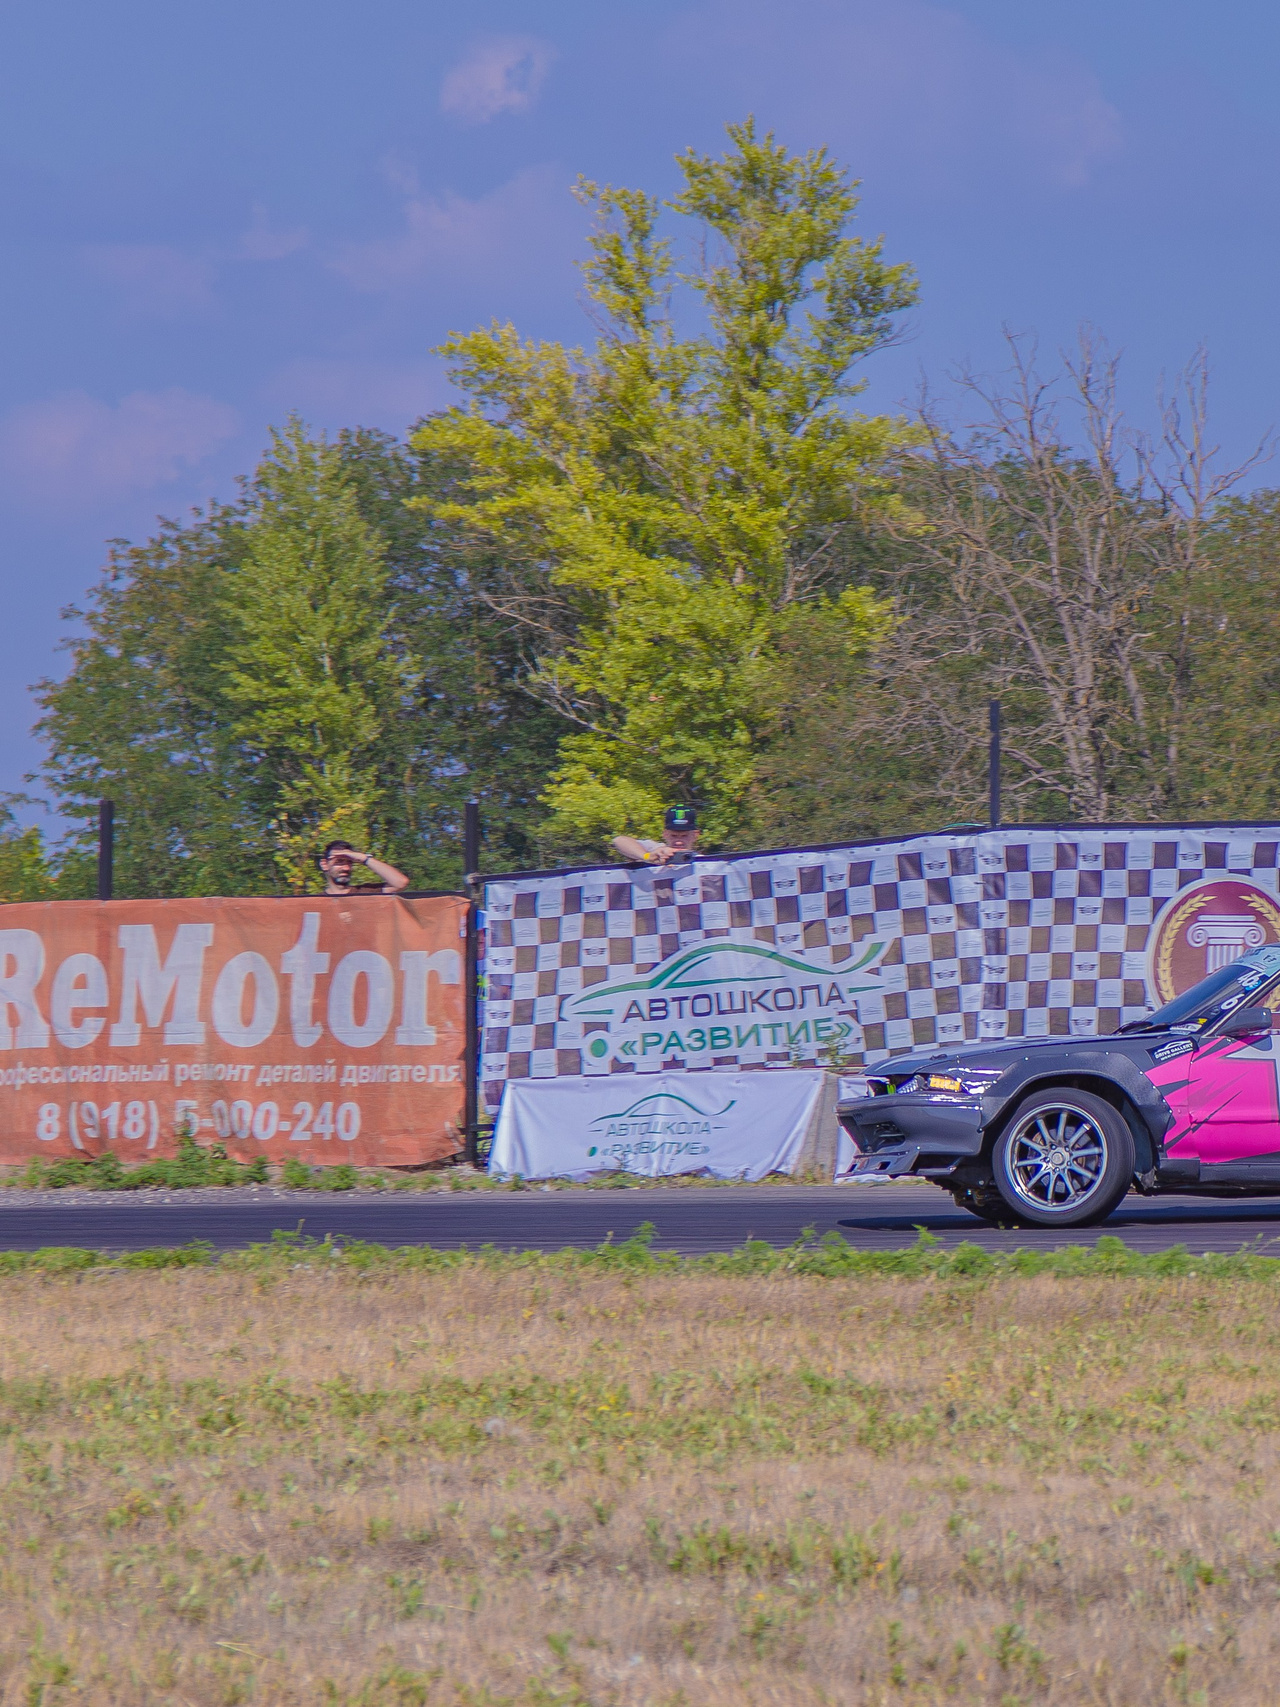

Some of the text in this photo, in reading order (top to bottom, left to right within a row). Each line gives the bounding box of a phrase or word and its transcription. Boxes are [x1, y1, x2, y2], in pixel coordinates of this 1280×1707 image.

[0, 911, 461, 1050] ReMotor
[621, 982, 846, 1023] АВТОШКОЛА
[618, 1017, 854, 1056] «РАЗВИТИЕ»
[1170, 1043, 1193, 1053] GALLERY
[256, 1058, 336, 1087] деталей
[340, 1064, 462, 1087] двигателя
[36, 1099, 361, 1149] 8 (918) 5-000-240
[605, 1121, 712, 1137] АВТОШКОЛА
